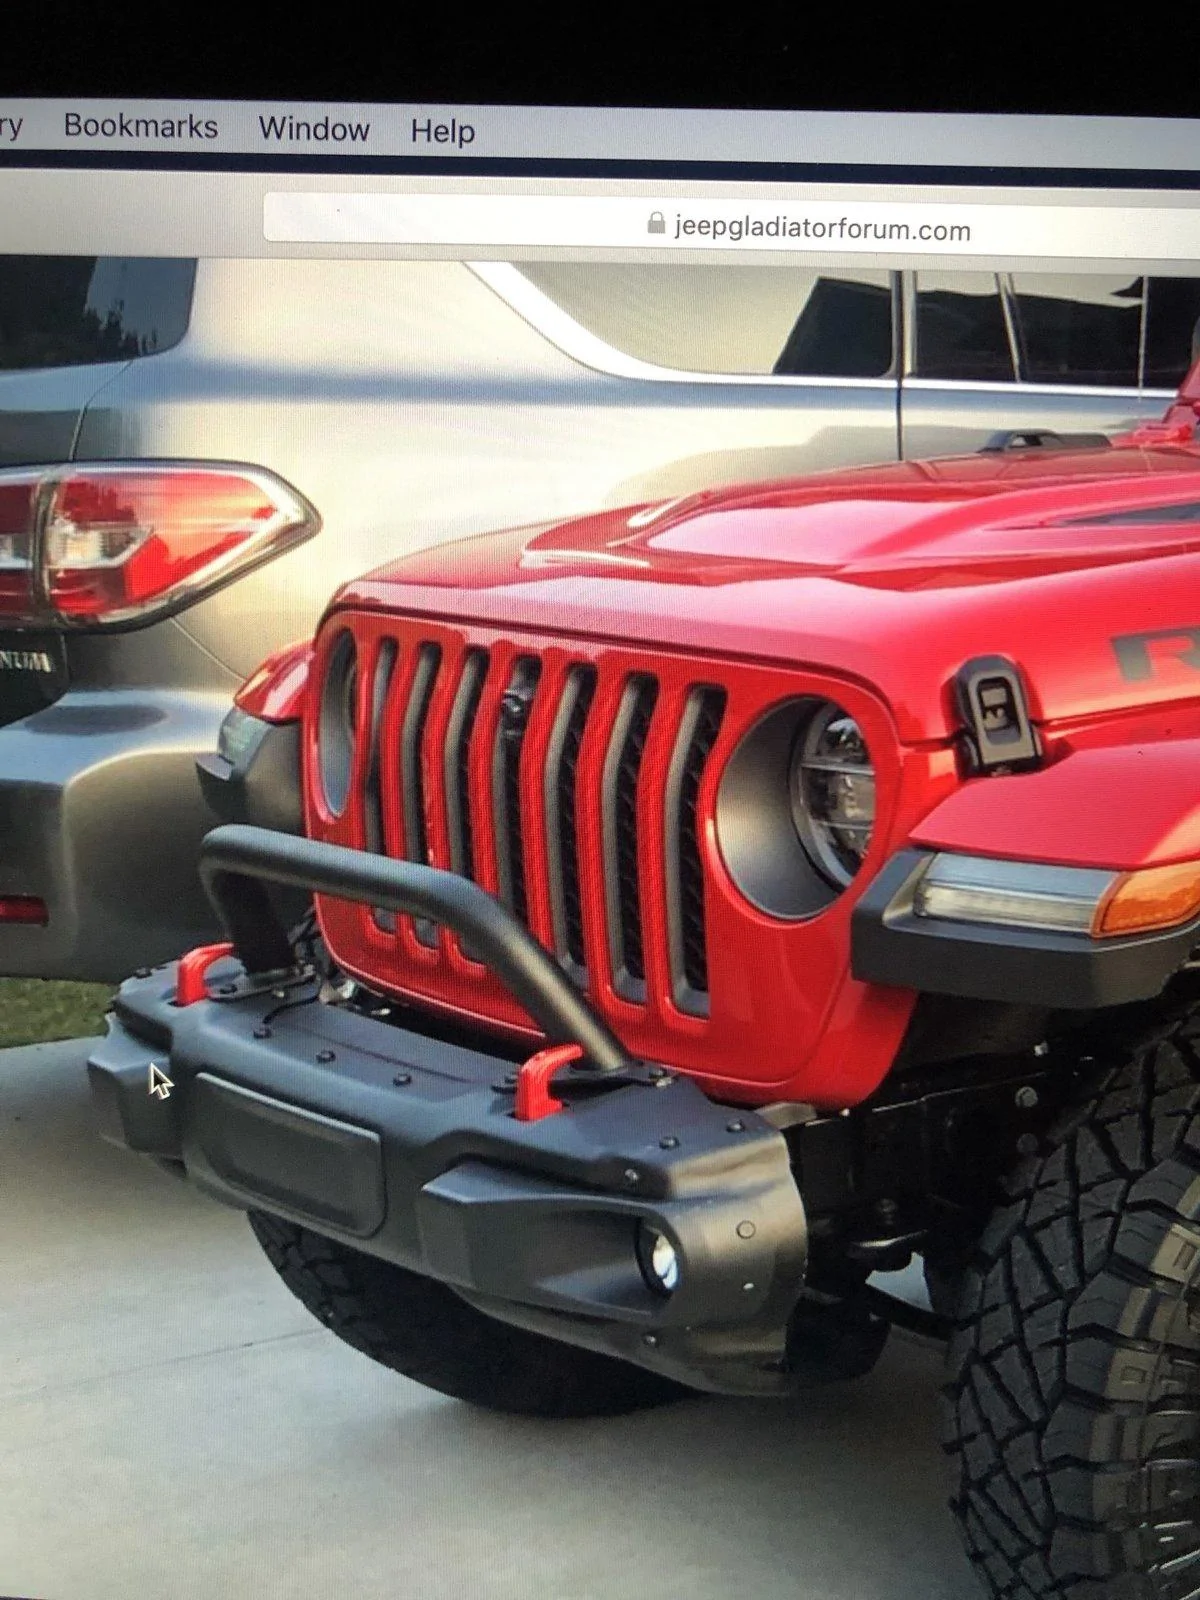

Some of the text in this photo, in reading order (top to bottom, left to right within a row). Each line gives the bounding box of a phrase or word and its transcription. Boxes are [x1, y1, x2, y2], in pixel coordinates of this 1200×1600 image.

[64, 112, 219, 139] Bookmarks
[259, 115, 371, 142] Window
[411, 118, 476, 148] Help
[674, 213, 971, 242] jeepgladiatorforum.com
